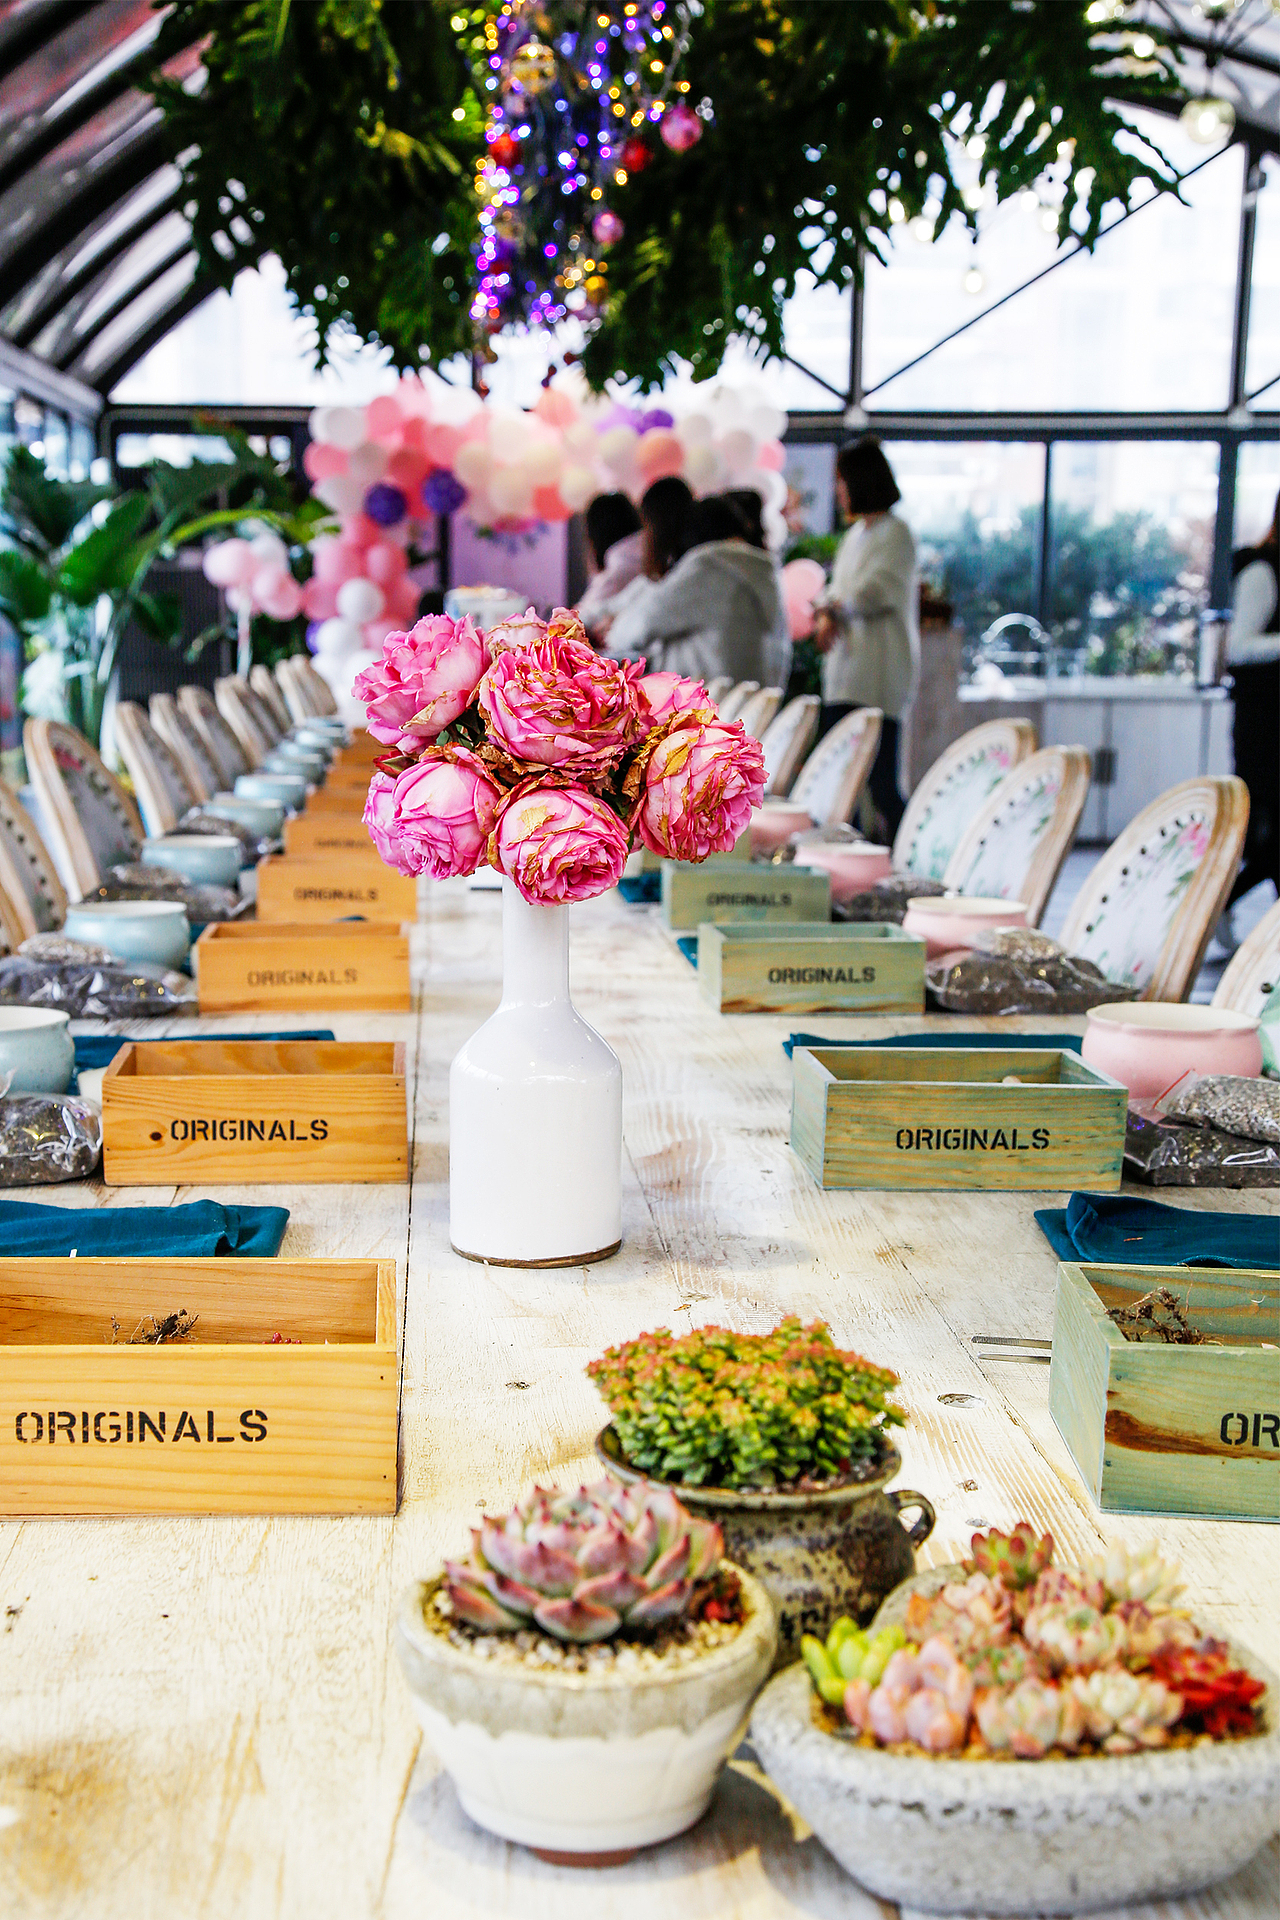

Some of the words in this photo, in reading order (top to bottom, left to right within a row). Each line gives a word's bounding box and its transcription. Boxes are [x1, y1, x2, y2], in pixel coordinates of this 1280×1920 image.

[247, 969, 358, 987] ORIGINALS
[767, 966, 876, 983] ORIGINALS
[170, 1119, 329, 1141] ORIGINALS
[896, 1128, 1050, 1150] ORIGINALS
[15, 1409, 268, 1444] ORIGINALS
[1220, 1412, 1280, 1448] OR
